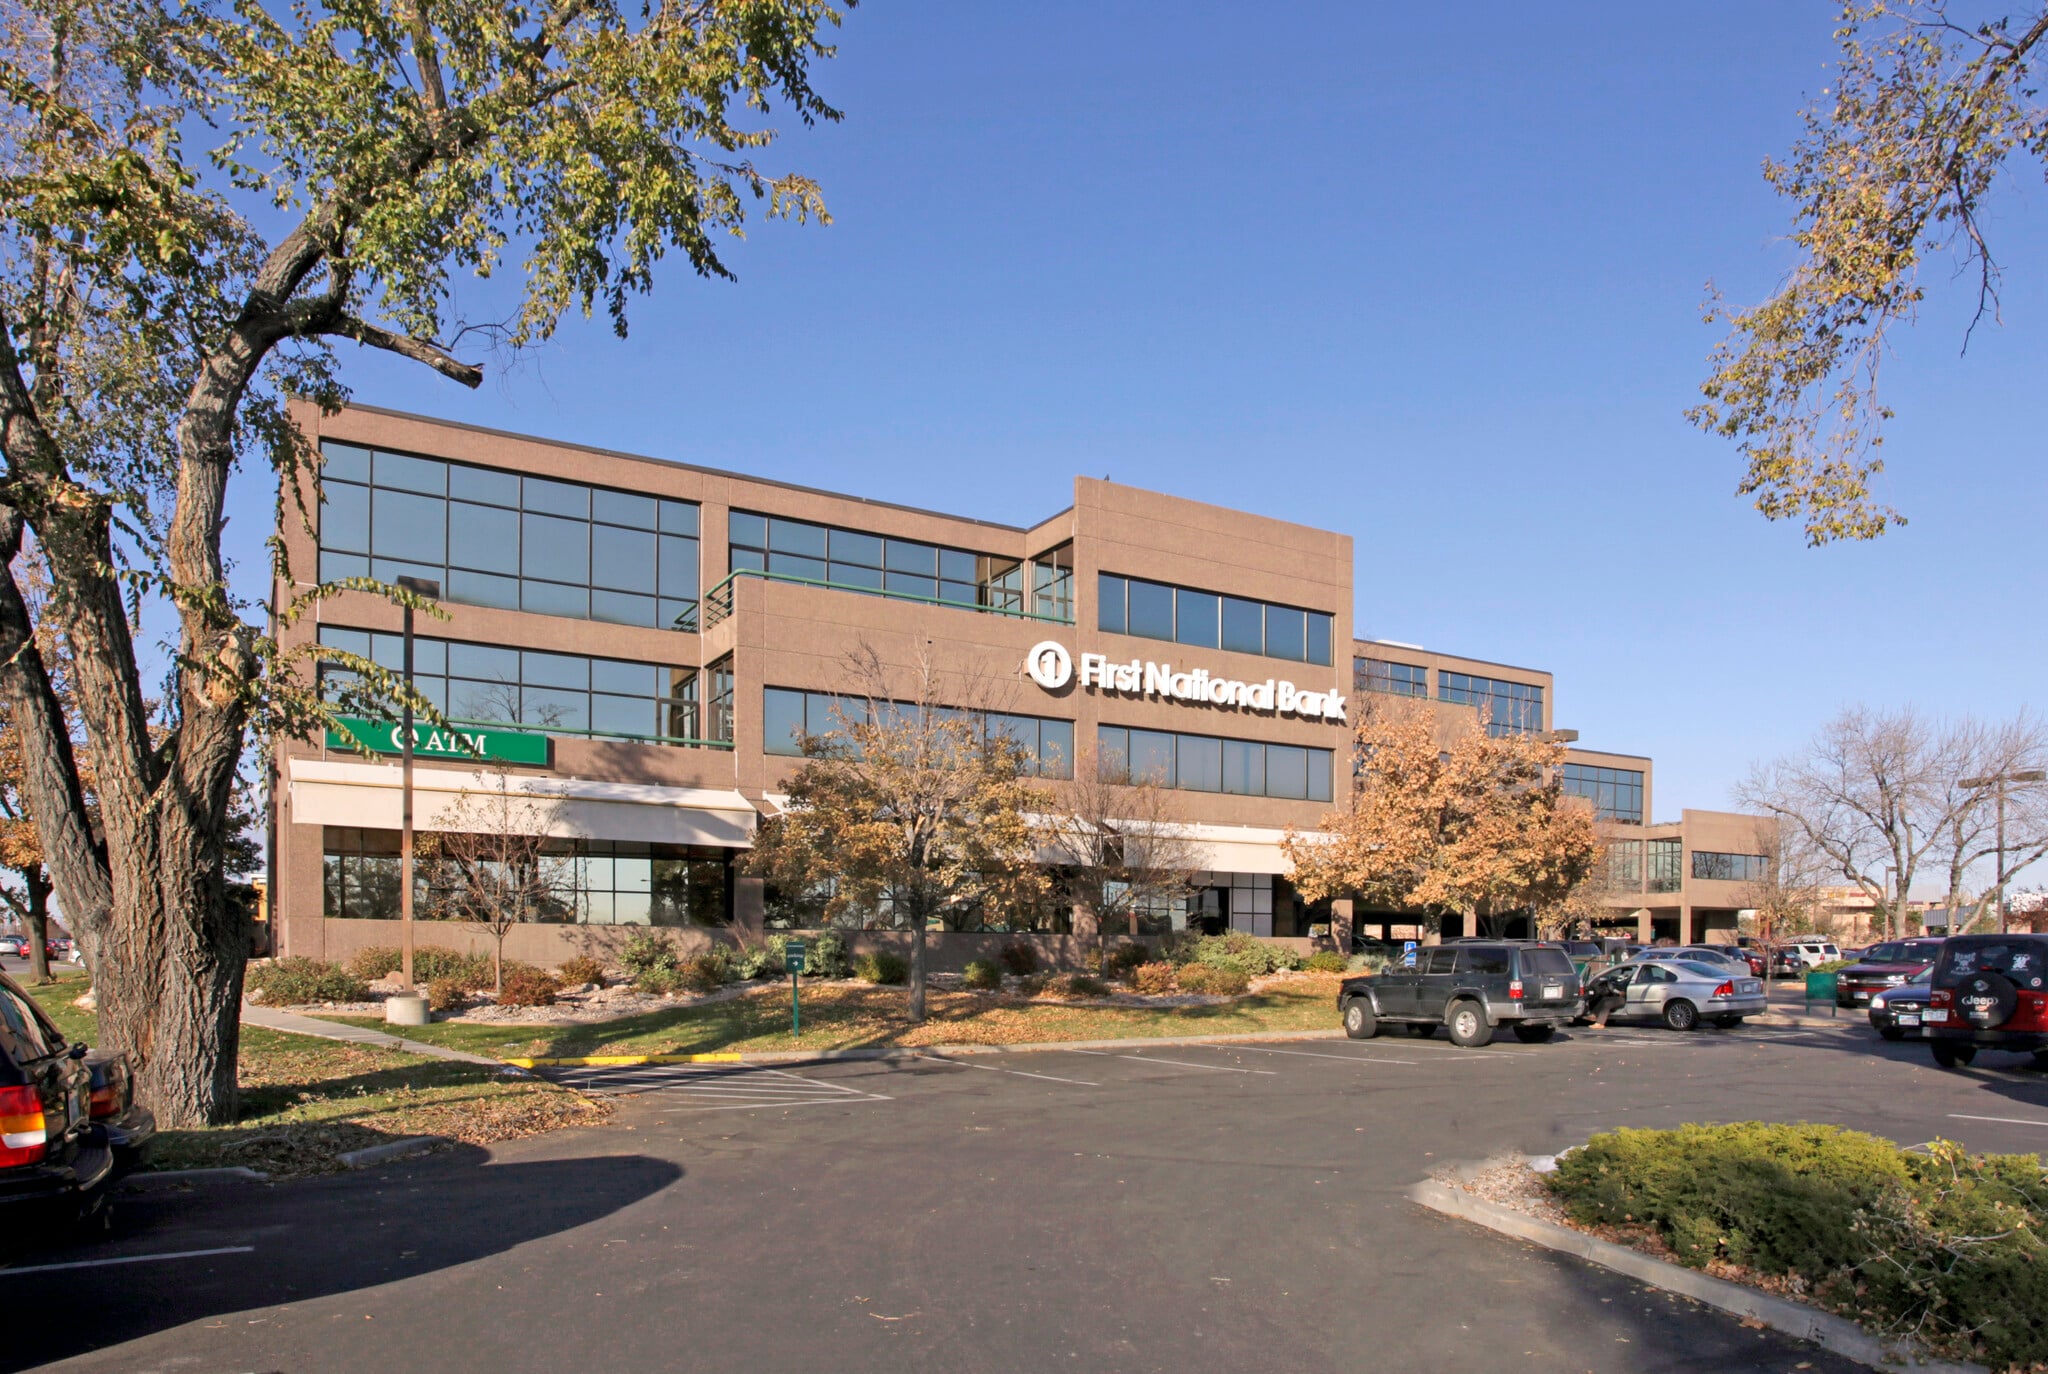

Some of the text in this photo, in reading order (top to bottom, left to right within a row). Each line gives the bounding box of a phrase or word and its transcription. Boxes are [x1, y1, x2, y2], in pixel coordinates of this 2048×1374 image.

[1081, 652, 1142, 692] First
[1145, 661, 1275, 710] National
[1278, 680, 1347, 719] Bank
[425, 730, 487, 755] ATM
[1966, 995, 1994, 1006] Jeep
